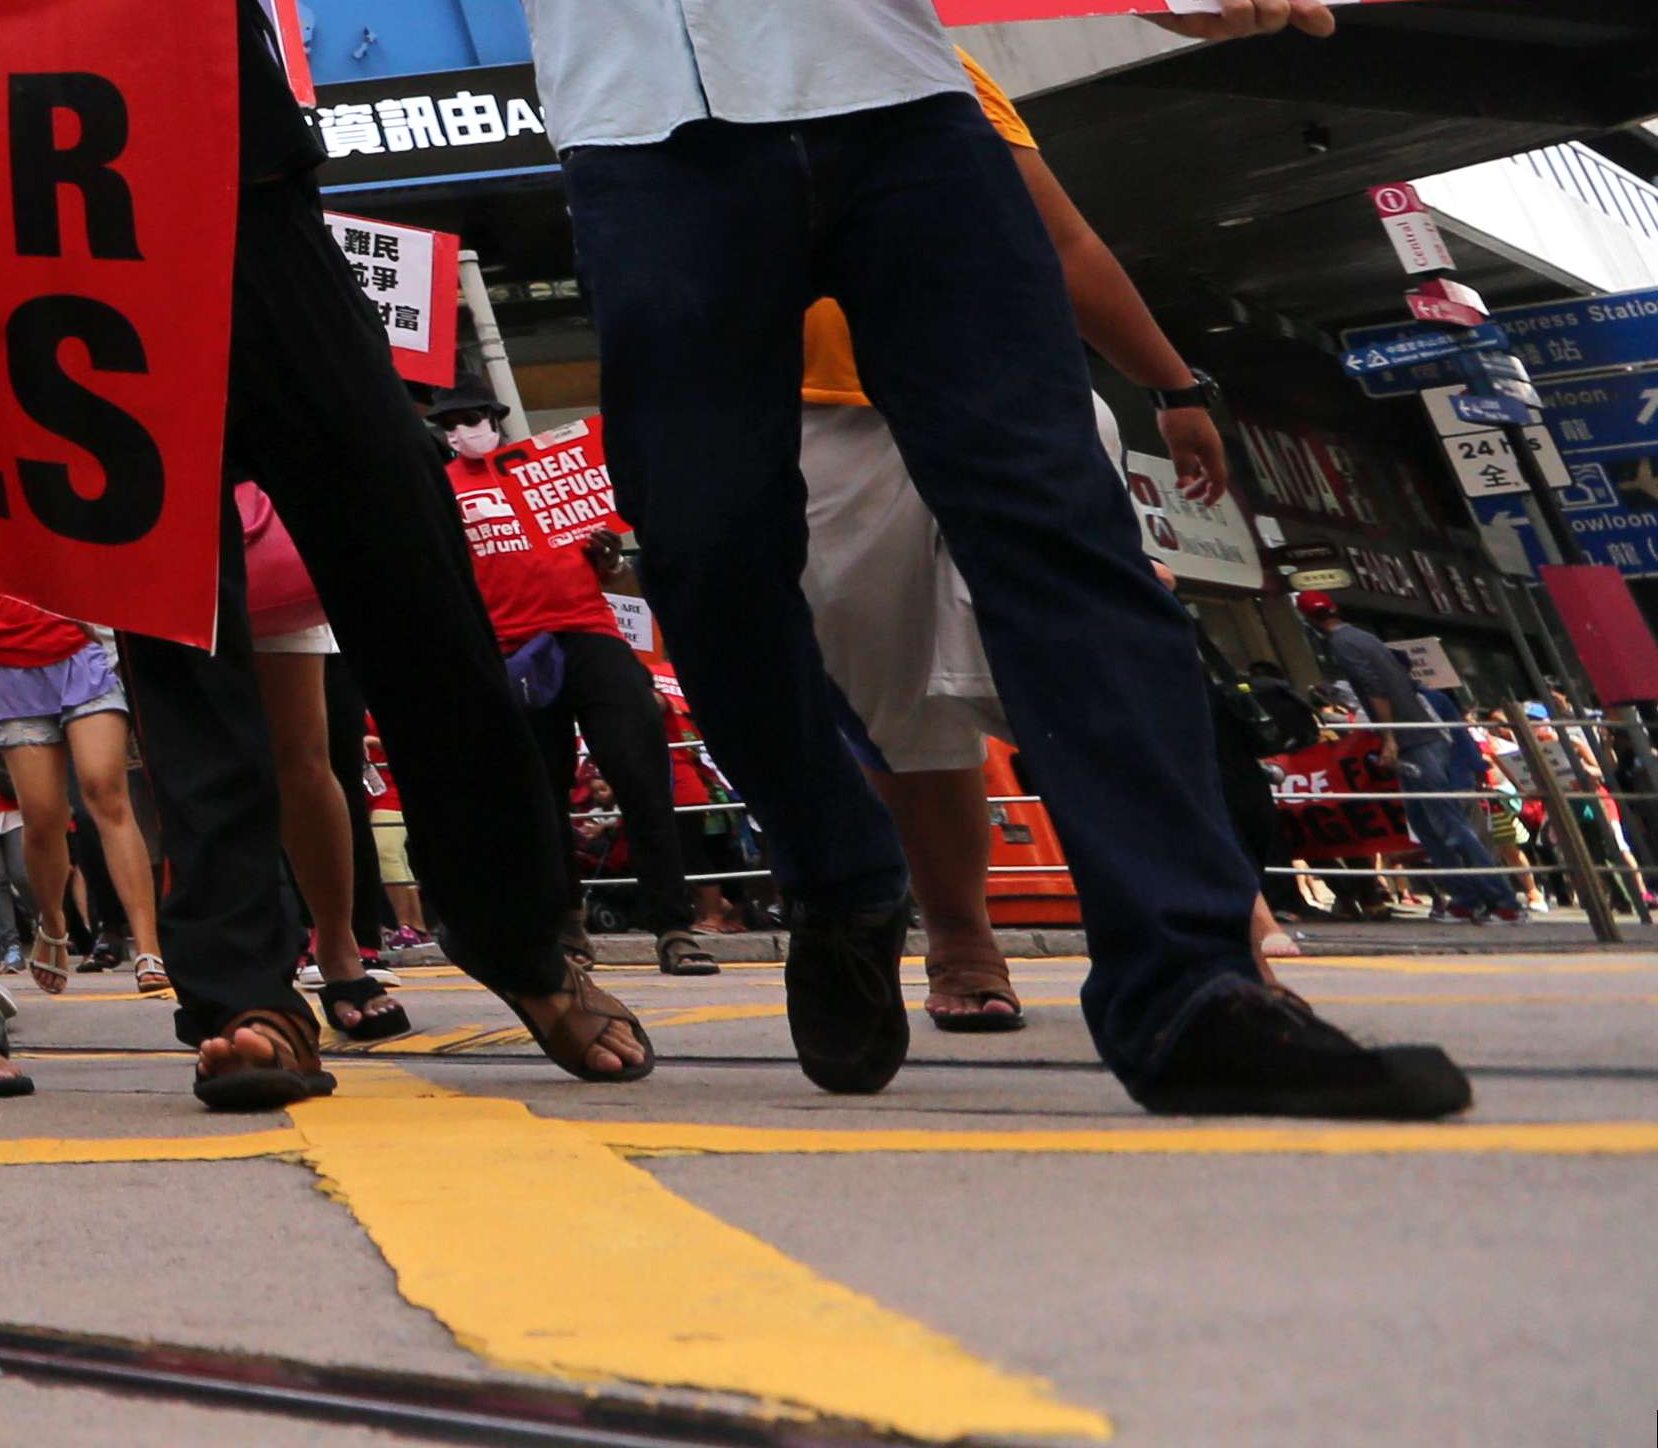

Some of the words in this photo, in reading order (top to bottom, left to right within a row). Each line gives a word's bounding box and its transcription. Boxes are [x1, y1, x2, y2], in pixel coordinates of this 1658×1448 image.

[304, 91, 546, 159] 資訊由A
[1502, 311, 1580, 336] xpress
[1588, 300, 1658, 323] Statio
[509, 446, 588, 487] TREAT
[1458, 440, 1495, 459] 24
[1499, 437, 1542, 454] hs
[522, 464, 612, 512] REFUG
[534, 489, 617, 534] FAIRLY
[1571, 511, 1658, 532] owloon
